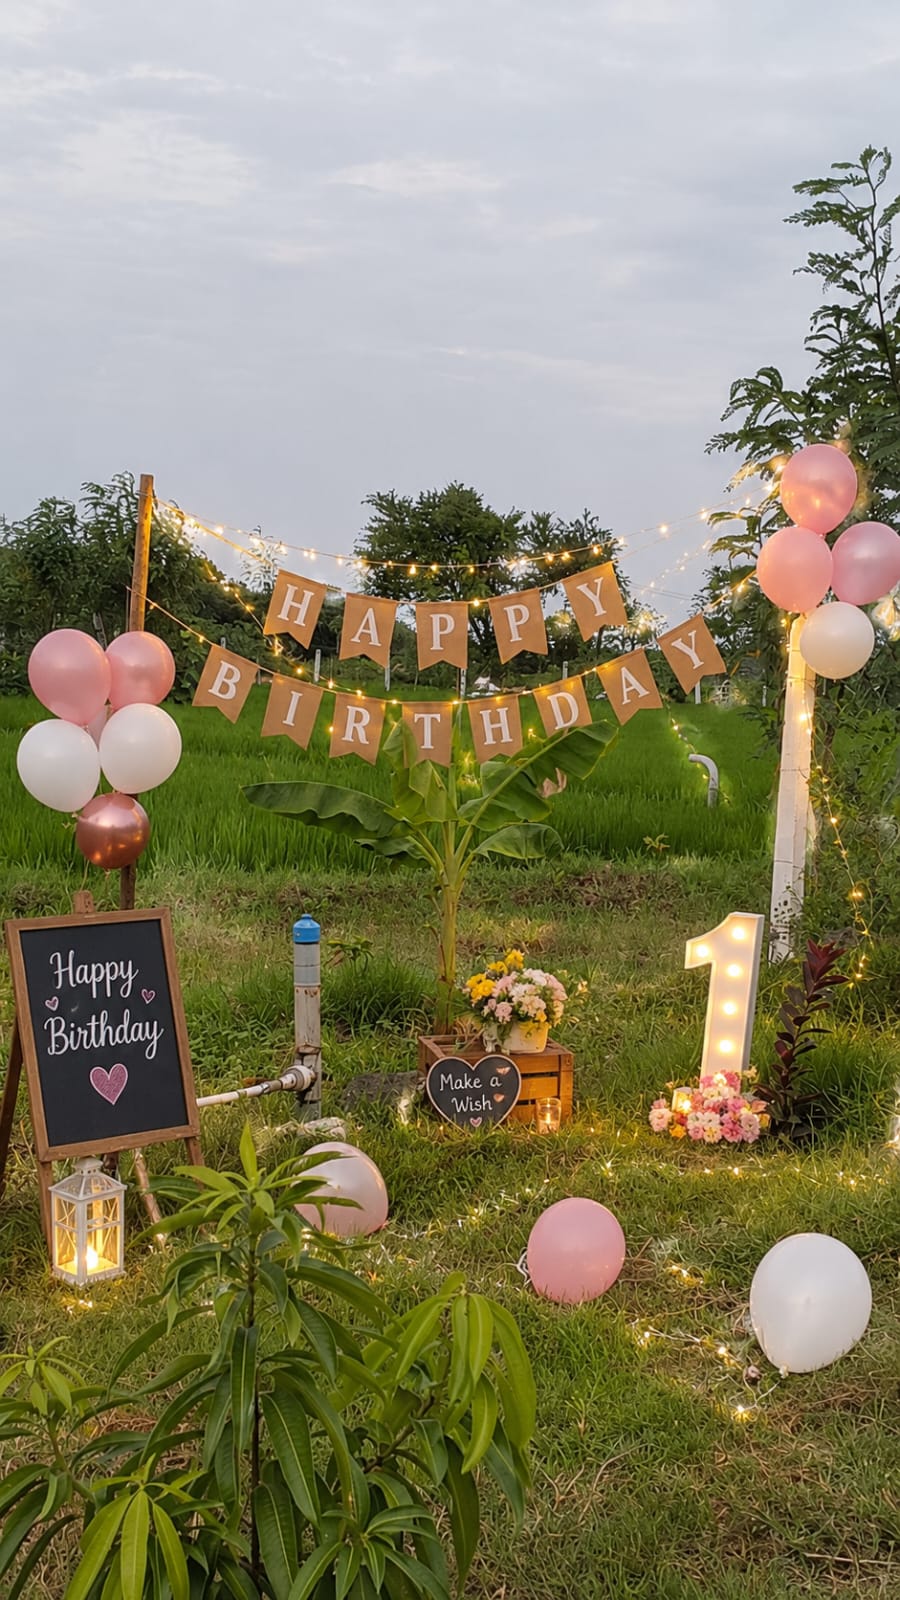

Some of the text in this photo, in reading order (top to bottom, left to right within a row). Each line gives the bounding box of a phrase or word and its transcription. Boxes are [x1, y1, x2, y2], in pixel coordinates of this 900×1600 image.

[277, 577, 606, 650] HAPPY
[208, 630, 704, 749] BIRTHDAY
[49, 950, 138, 998] Happy
[685, 911, 765, 1080] 1
[43, 1009, 164, 1060] Birthday
[439, 1073, 503, 1091] Make a
[451, 1094, 493, 1112] Wish
